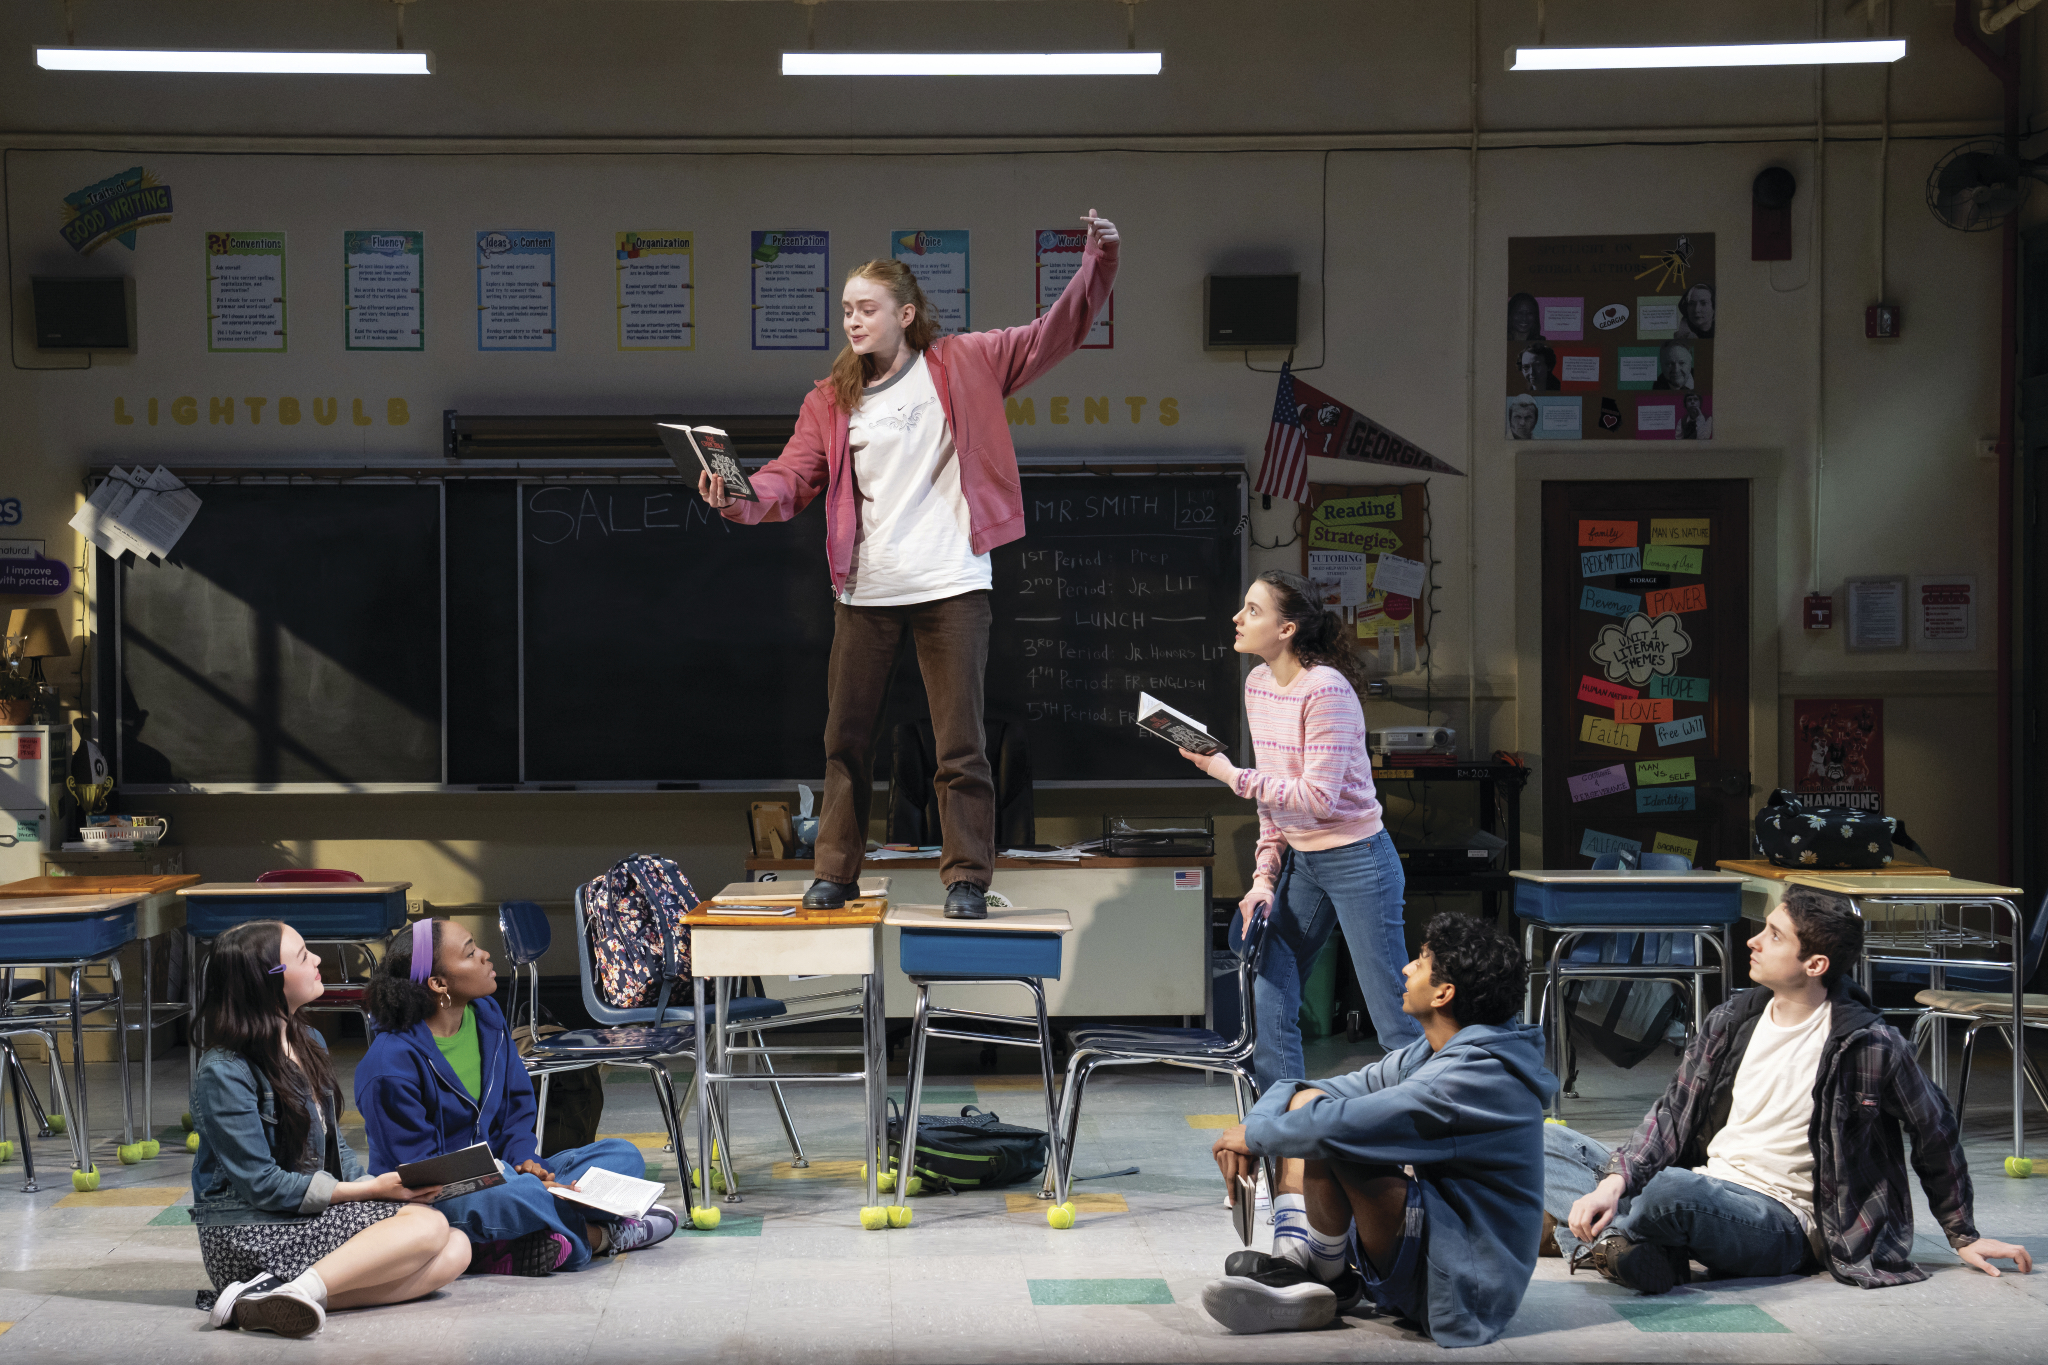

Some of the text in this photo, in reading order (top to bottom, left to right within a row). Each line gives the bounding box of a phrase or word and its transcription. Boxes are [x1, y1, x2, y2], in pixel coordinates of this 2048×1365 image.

[87, 180, 127, 205] Traits of
[66, 209, 105, 244] GOOD
[106, 189, 168, 222] WRITING
[230, 238, 282, 249] Conventions
[372, 236, 405, 249] Fluency
[486, 237, 507, 248] Ideas
[520, 237, 552, 248] Content
[636, 238, 690, 249] Organization
[772, 235, 825, 246] Presentation
[919, 236, 942, 247] Voice
[1057, 235, 1080, 246] Word
[1615, 243, 1633, 253] ON
[1529, 263, 1648, 274] GEORGIA AUTHORS
[1599, 315, 1626, 328] GEORGIA
[114, 396, 1180, 426] LIGHTBULB MENTS
[1346, 421, 1433, 470] GEORGIA
[529, 486, 730, 544] SALEM
[1035, 496, 1159, 522] MR. SMITH
[1182, 506, 1216, 523] 202
[1324, 502, 1396, 520] Reading
[1314, 526, 1397, 551] Strategies
[1588, 527, 1623, 543] family
[1651, 528, 1709, 539] MAN VS NATURE
[1131, 549, 1169, 566] Prep
[1311, 554, 1362, 563] TUTORING
[1582, 552, 1640, 574] REDEMPTION
[1645, 548, 1694, 571] Coming of Age
[6, 566, 51, 577] I improve
[19, 577, 62, 586] practice.
[1166, 575, 1200, 592] LIT
[1585, 588, 1635, 617] Revenge
[1654, 588, 1703, 614] POWER
[1075, 611, 1145, 630] LUNCH
[1618, 630, 1659, 647] UNIT 1
[1202, 643, 1228, 661] LIT
[1613, 641, 1669, 662] LITERARY
[1622, 655, 1666, 671] THEMES
[1150, 675, 1206, 691] ENGLISH
[1582, 683, 1608, 697] HUMAN
[1661, 679, 1696, 698] HOPE
[1621, 702, 1661, 720] LOVE
[1588, 718, 1629, 748] Faith
[1682, 718, 1703, 736] Will
[1471, 768, 1490, 778] 202
[1638, 763, 1659, 772] MAN
[1654, 770, 1668, 778] VS.
[1669, 772, 1690, 781] SELF
[1574, 782, 1628, 801] PERSEVERANCE
[1643, 795, 1689, 811] Identity
[1656, 842, 1692, 856] SACRIFICE
